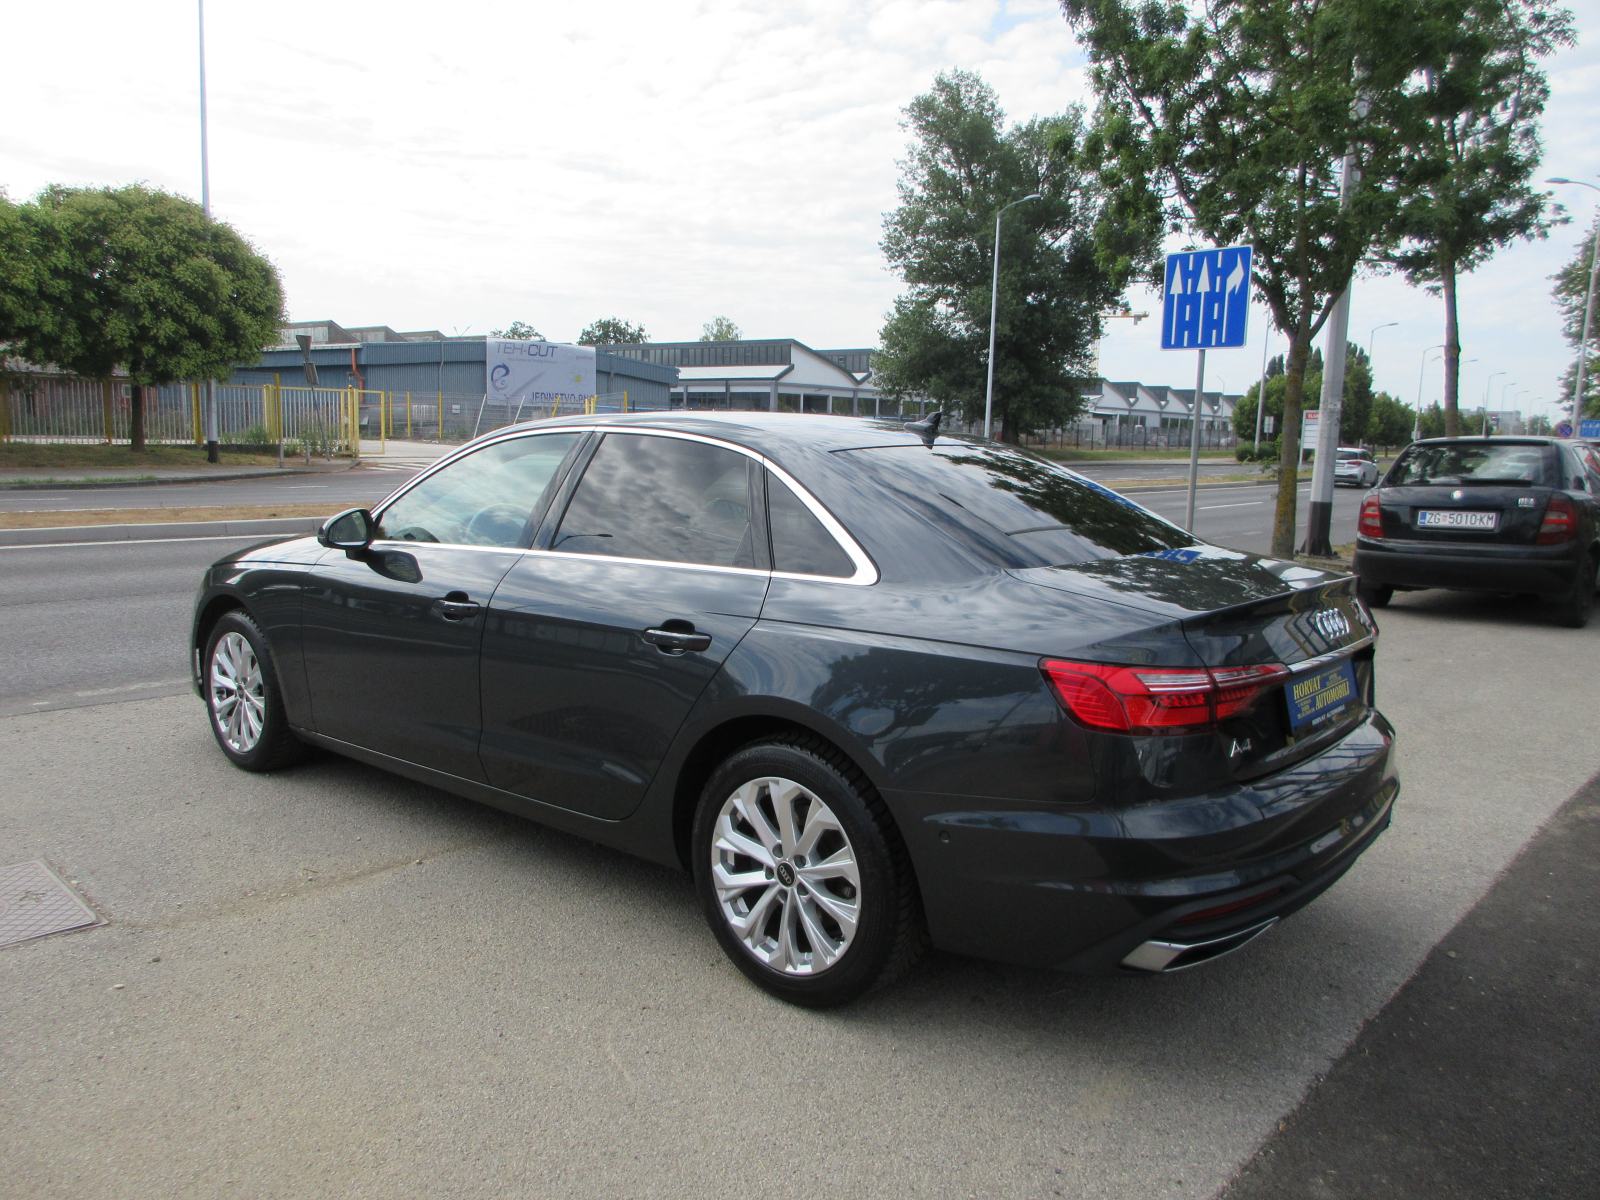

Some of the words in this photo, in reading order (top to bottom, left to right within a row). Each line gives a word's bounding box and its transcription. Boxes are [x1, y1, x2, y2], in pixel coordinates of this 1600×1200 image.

[1427, 512, 1441, 524] ZG
[1293, 675, 1321, 700] HORVAT
[1230, 737, 1252, 757] A4
